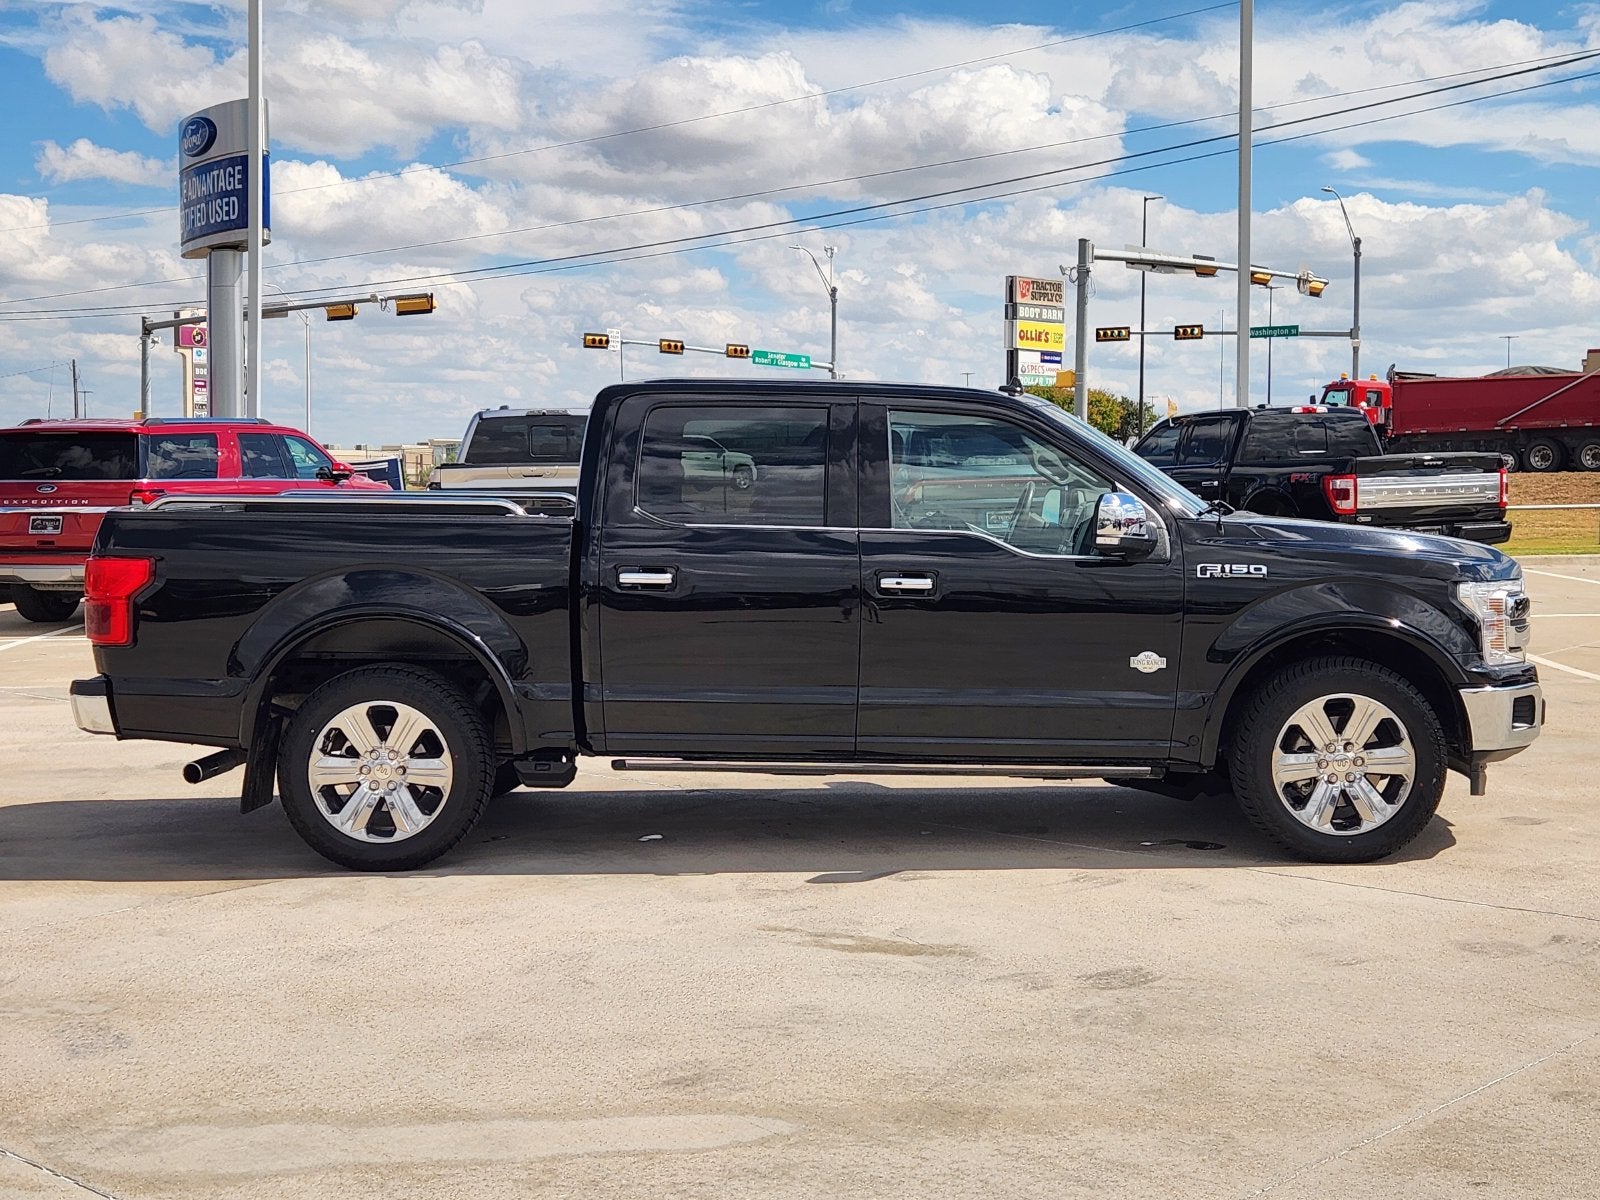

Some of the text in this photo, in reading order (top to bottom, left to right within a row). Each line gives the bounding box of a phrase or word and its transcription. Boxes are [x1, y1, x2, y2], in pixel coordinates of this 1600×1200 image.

[183, 124, 202, 150] Ford
[188, 165, 243, 201] ADVANTAGE
[208, 196, 239, 224] USED
[1031, 280, 1063, 292] TRACTOR
[1030, 290, 1055, 302] SUPPLY
[1019, 306, 1063, 320] BOOT BARN
[957, 482, 1047, 490] LINCON
[1382, 486, 1480, 497] PLATINUM
